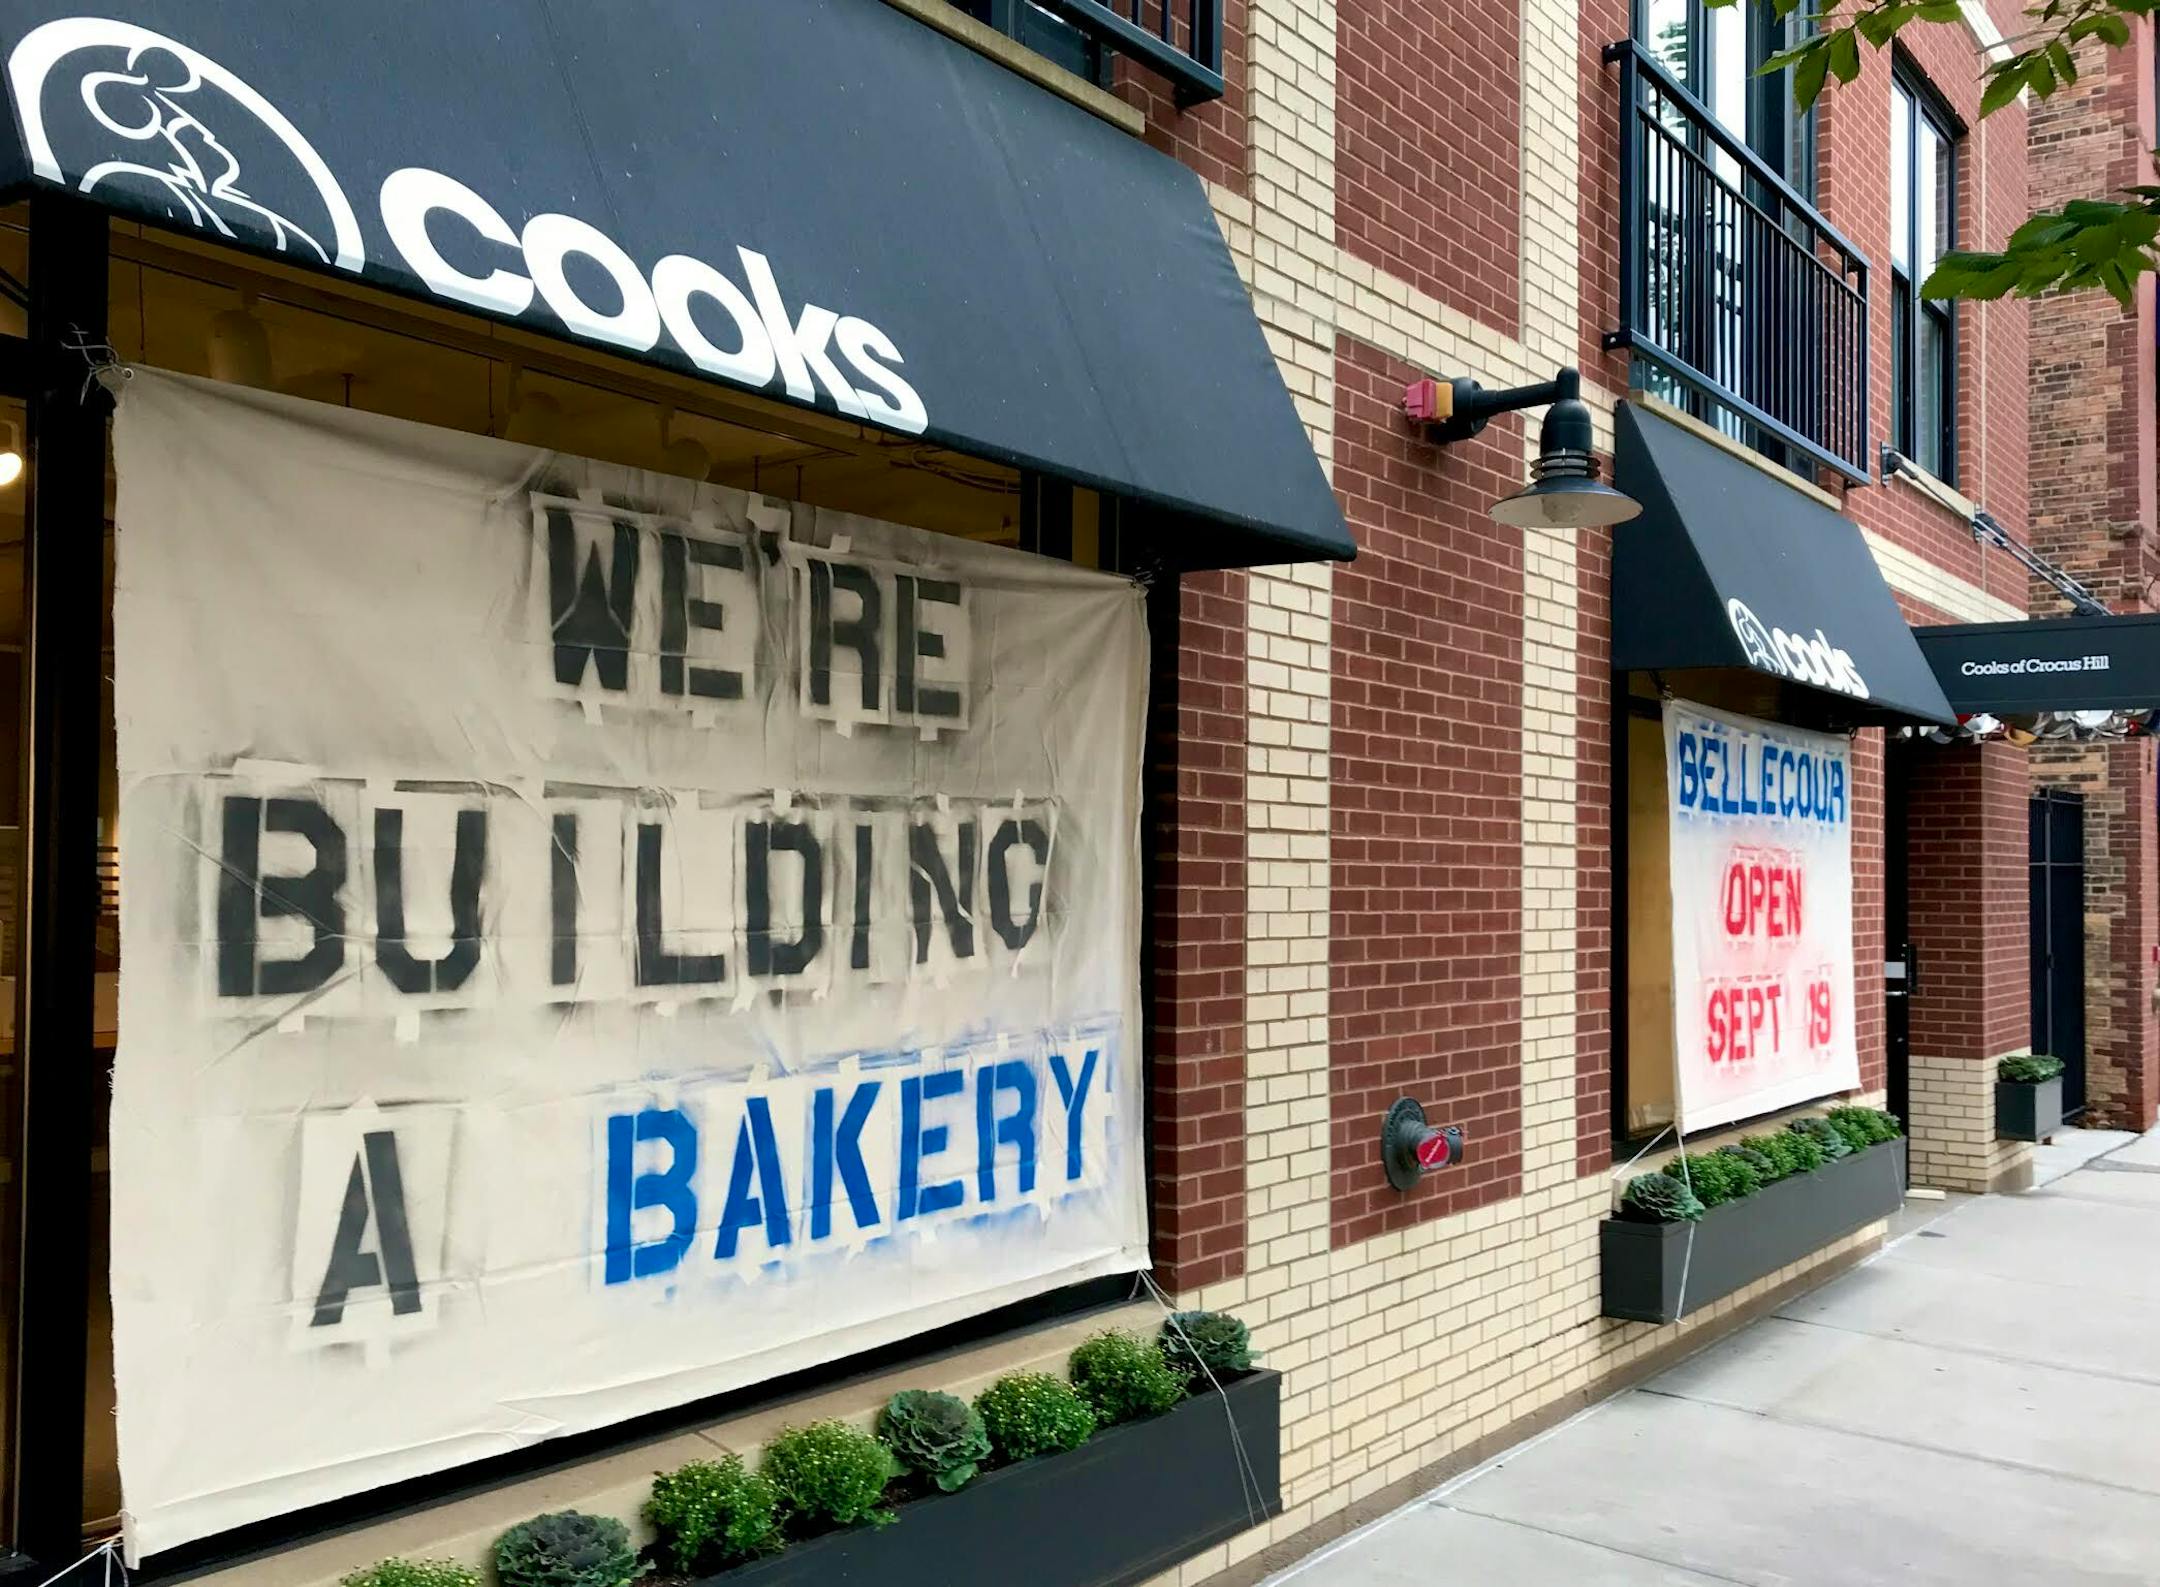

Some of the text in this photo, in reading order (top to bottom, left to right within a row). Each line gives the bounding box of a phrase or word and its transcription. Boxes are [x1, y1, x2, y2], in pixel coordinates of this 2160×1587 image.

[380, 167, 928, 435] cooks
[547, 509, 961, 718] WE'RE
[1961, 655, 2110, 676] Cooks of Crocus Hill
[1679, 730, 1844, 823] BELLECOUR
[218, 796, 1048, 997] BUILDING
[1725, 863, 1802, 937] OPEN
[1707, 981, 1832, 1064] SEPT 19
[310, 1049, 1099, 1328] A BAKERY
